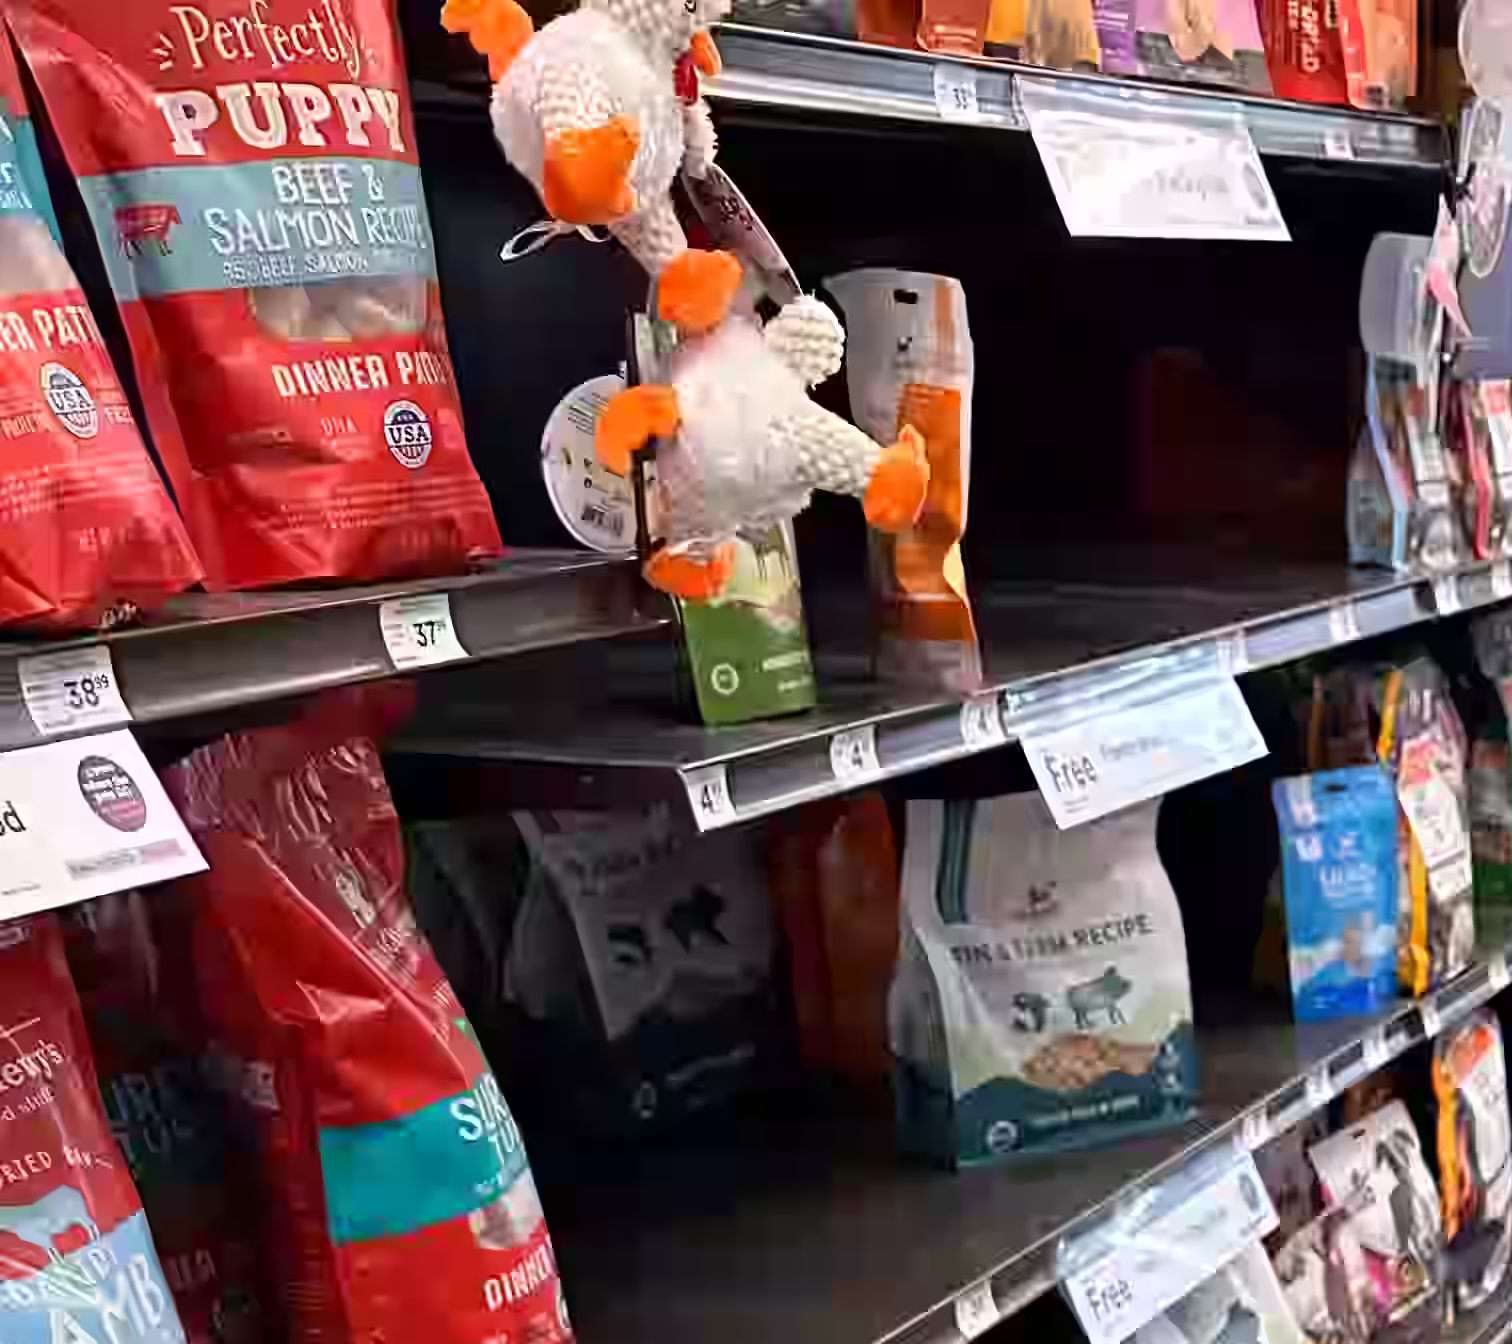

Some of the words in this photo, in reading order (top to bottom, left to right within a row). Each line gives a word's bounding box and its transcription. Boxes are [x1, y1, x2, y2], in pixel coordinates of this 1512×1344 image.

[169, 0, 361, 80] Perfectly
[155, 82, 404, 156] PUPPY
[272, 163, 354, 205] BEEF
[361, 164, 385, 201] &
[204, 207, 362, 255] SALMON
[271, 355, 390, 398] DINNER
[50, 387, 95, 411] USA
[388, 423, 429, 446] USA
[1042, 750, 1097, 793] Free
[1071, 913, 1154, 946] RECIPE
